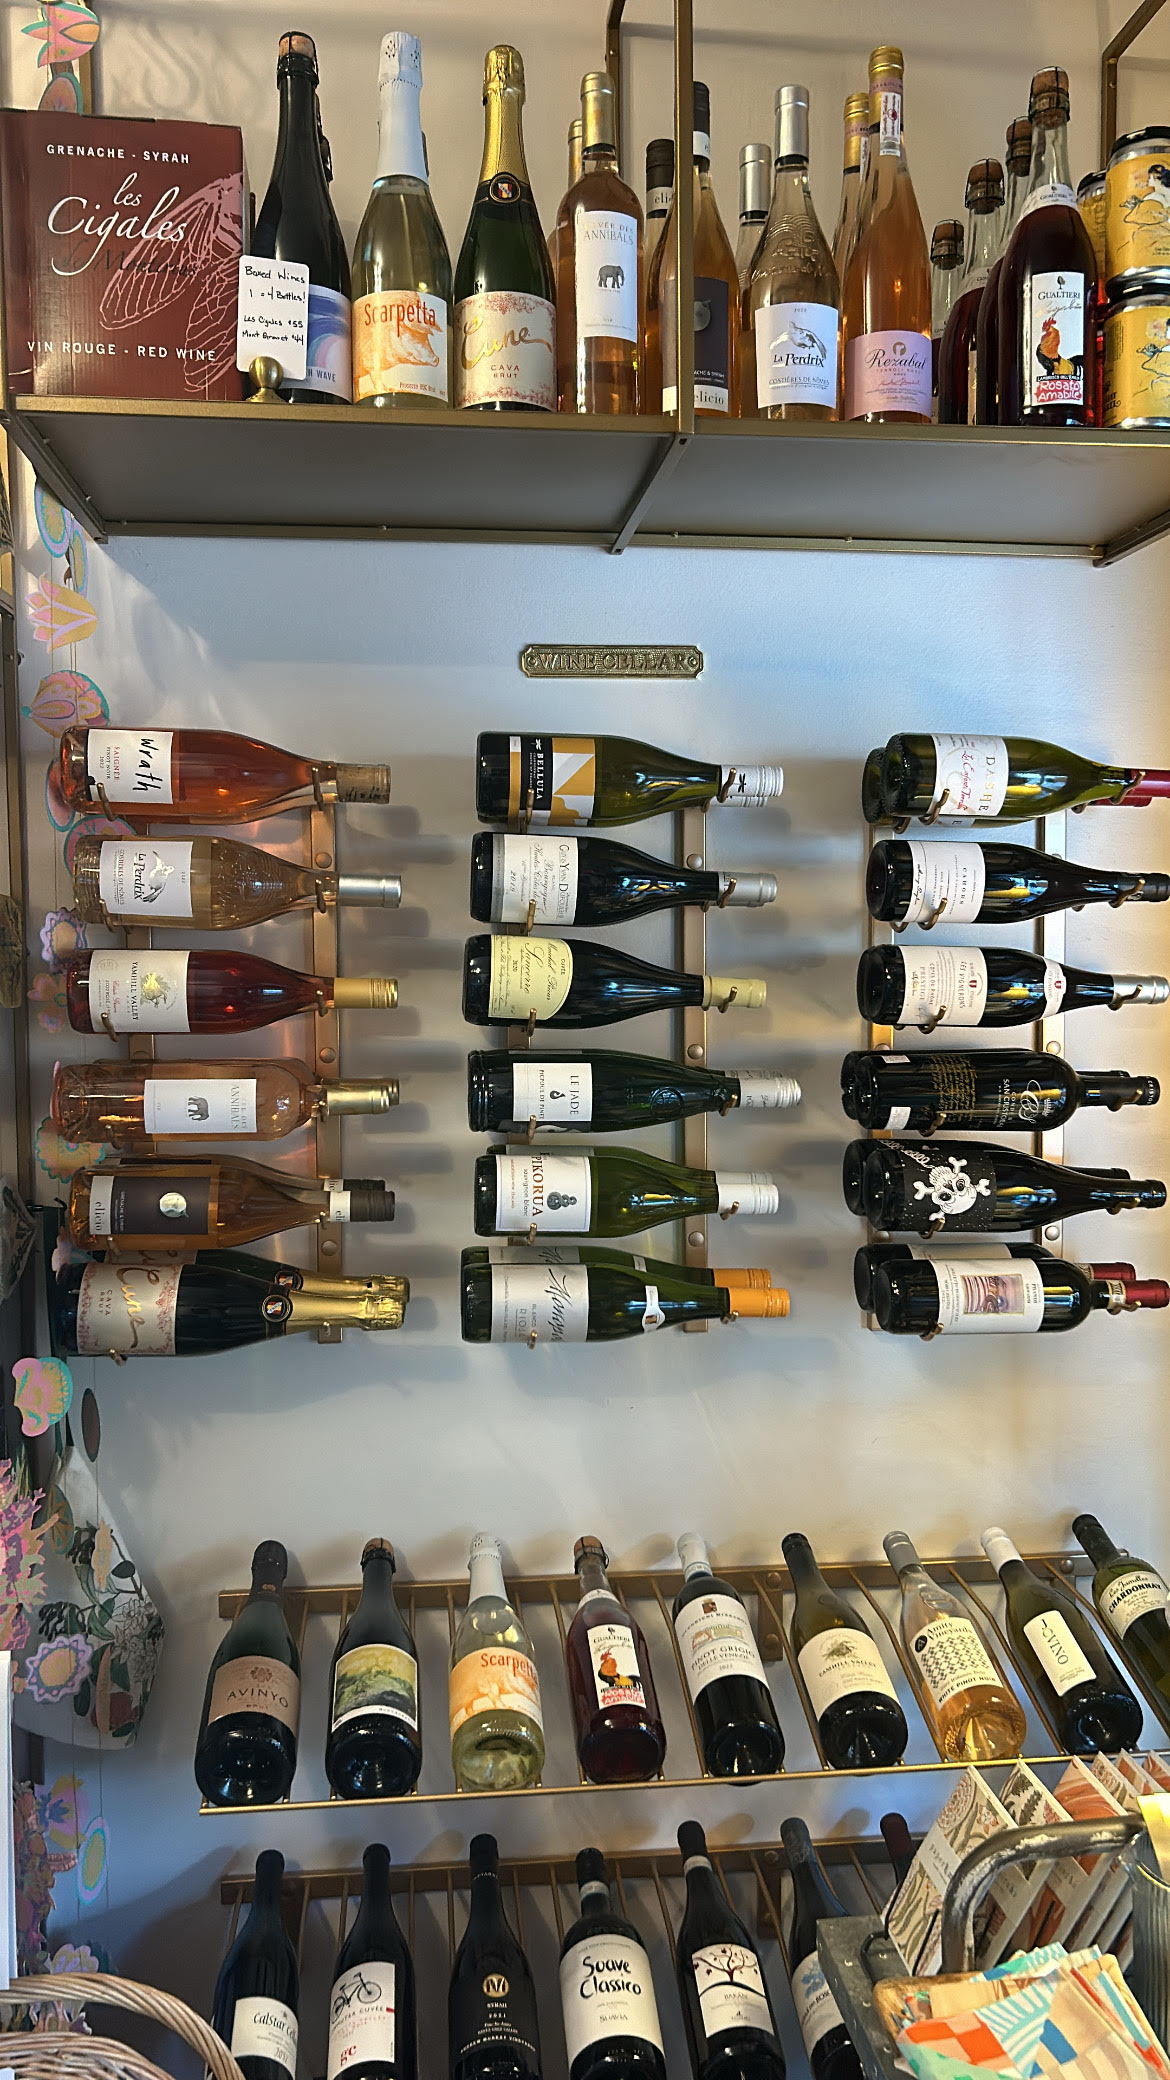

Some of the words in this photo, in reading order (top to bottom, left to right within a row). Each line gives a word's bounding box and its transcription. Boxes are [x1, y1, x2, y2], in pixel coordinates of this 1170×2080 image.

[46, 144, 125, 159] GRENACHE
[143, 150, 189, 164] SYRAH
[113, 172, 142, 206] les
[47, 186, 187, 276] Cigales
[583, 230, 634, 246] ANNIBALS
[244, 265, 272, 279] Boxed
[278, 268, 305, 283] Wines
[1038, 291, 1081, 300] GUALTIERI
[243, 315, 256, 323] Les
[364, 301, 436, 337] Scarpetta
[242, 329, 260, 338] Mont
[27, 341, 53, 352] VIN
[62, 342, 116, 355] ROUGE
[137, 346, 167, 358] RED
[176, 347, 216, 361] WINE
[773, 354, 783, 363] La
[785, 352, 824, 368] Perdrix
[316, 369, 335, 382] WAVE
[490, 364, 520, 372] CAVA
[1038, 390, 1082, 401] Amabile
[1040, 381, 1080, 390] Rosato
[539, 653, 598, 670] WINE
[602, 653, 687, 670] CELLAR
[536, 752, 545, 800] BELLULA
[978, 756, 996, 811] DASHE
[133, 862, 147, 901] Perdrix
[959, 867, 968, 905] CAHORS
[131, 961, 139, 993] YAMHILL
[524, 942, 545, 994] Sancerre
[131, 995, 139, 1021] VALLEY
[569, 1075, 579, 1086] LE
[569, 1089, 579, 1116] JADE
[94, 1201, 106, 1231] elicio
[105, 1289, 113, 1316] CAVA
[1108, 1582, 1161, 1614] CHARDONNAY
[692, 1648, 716, 1671] PINOT
[720, 1645, 755, 1658] GRIGIO
[938, 1686, 955, 1703] WHITE
[956, 1677, 977, 1688] PINOT
[582, 1955, 632, 1979] Soave
[579, 1974, 642, 1999] Classico
[253, 2012, 286, 2031] CalStar
